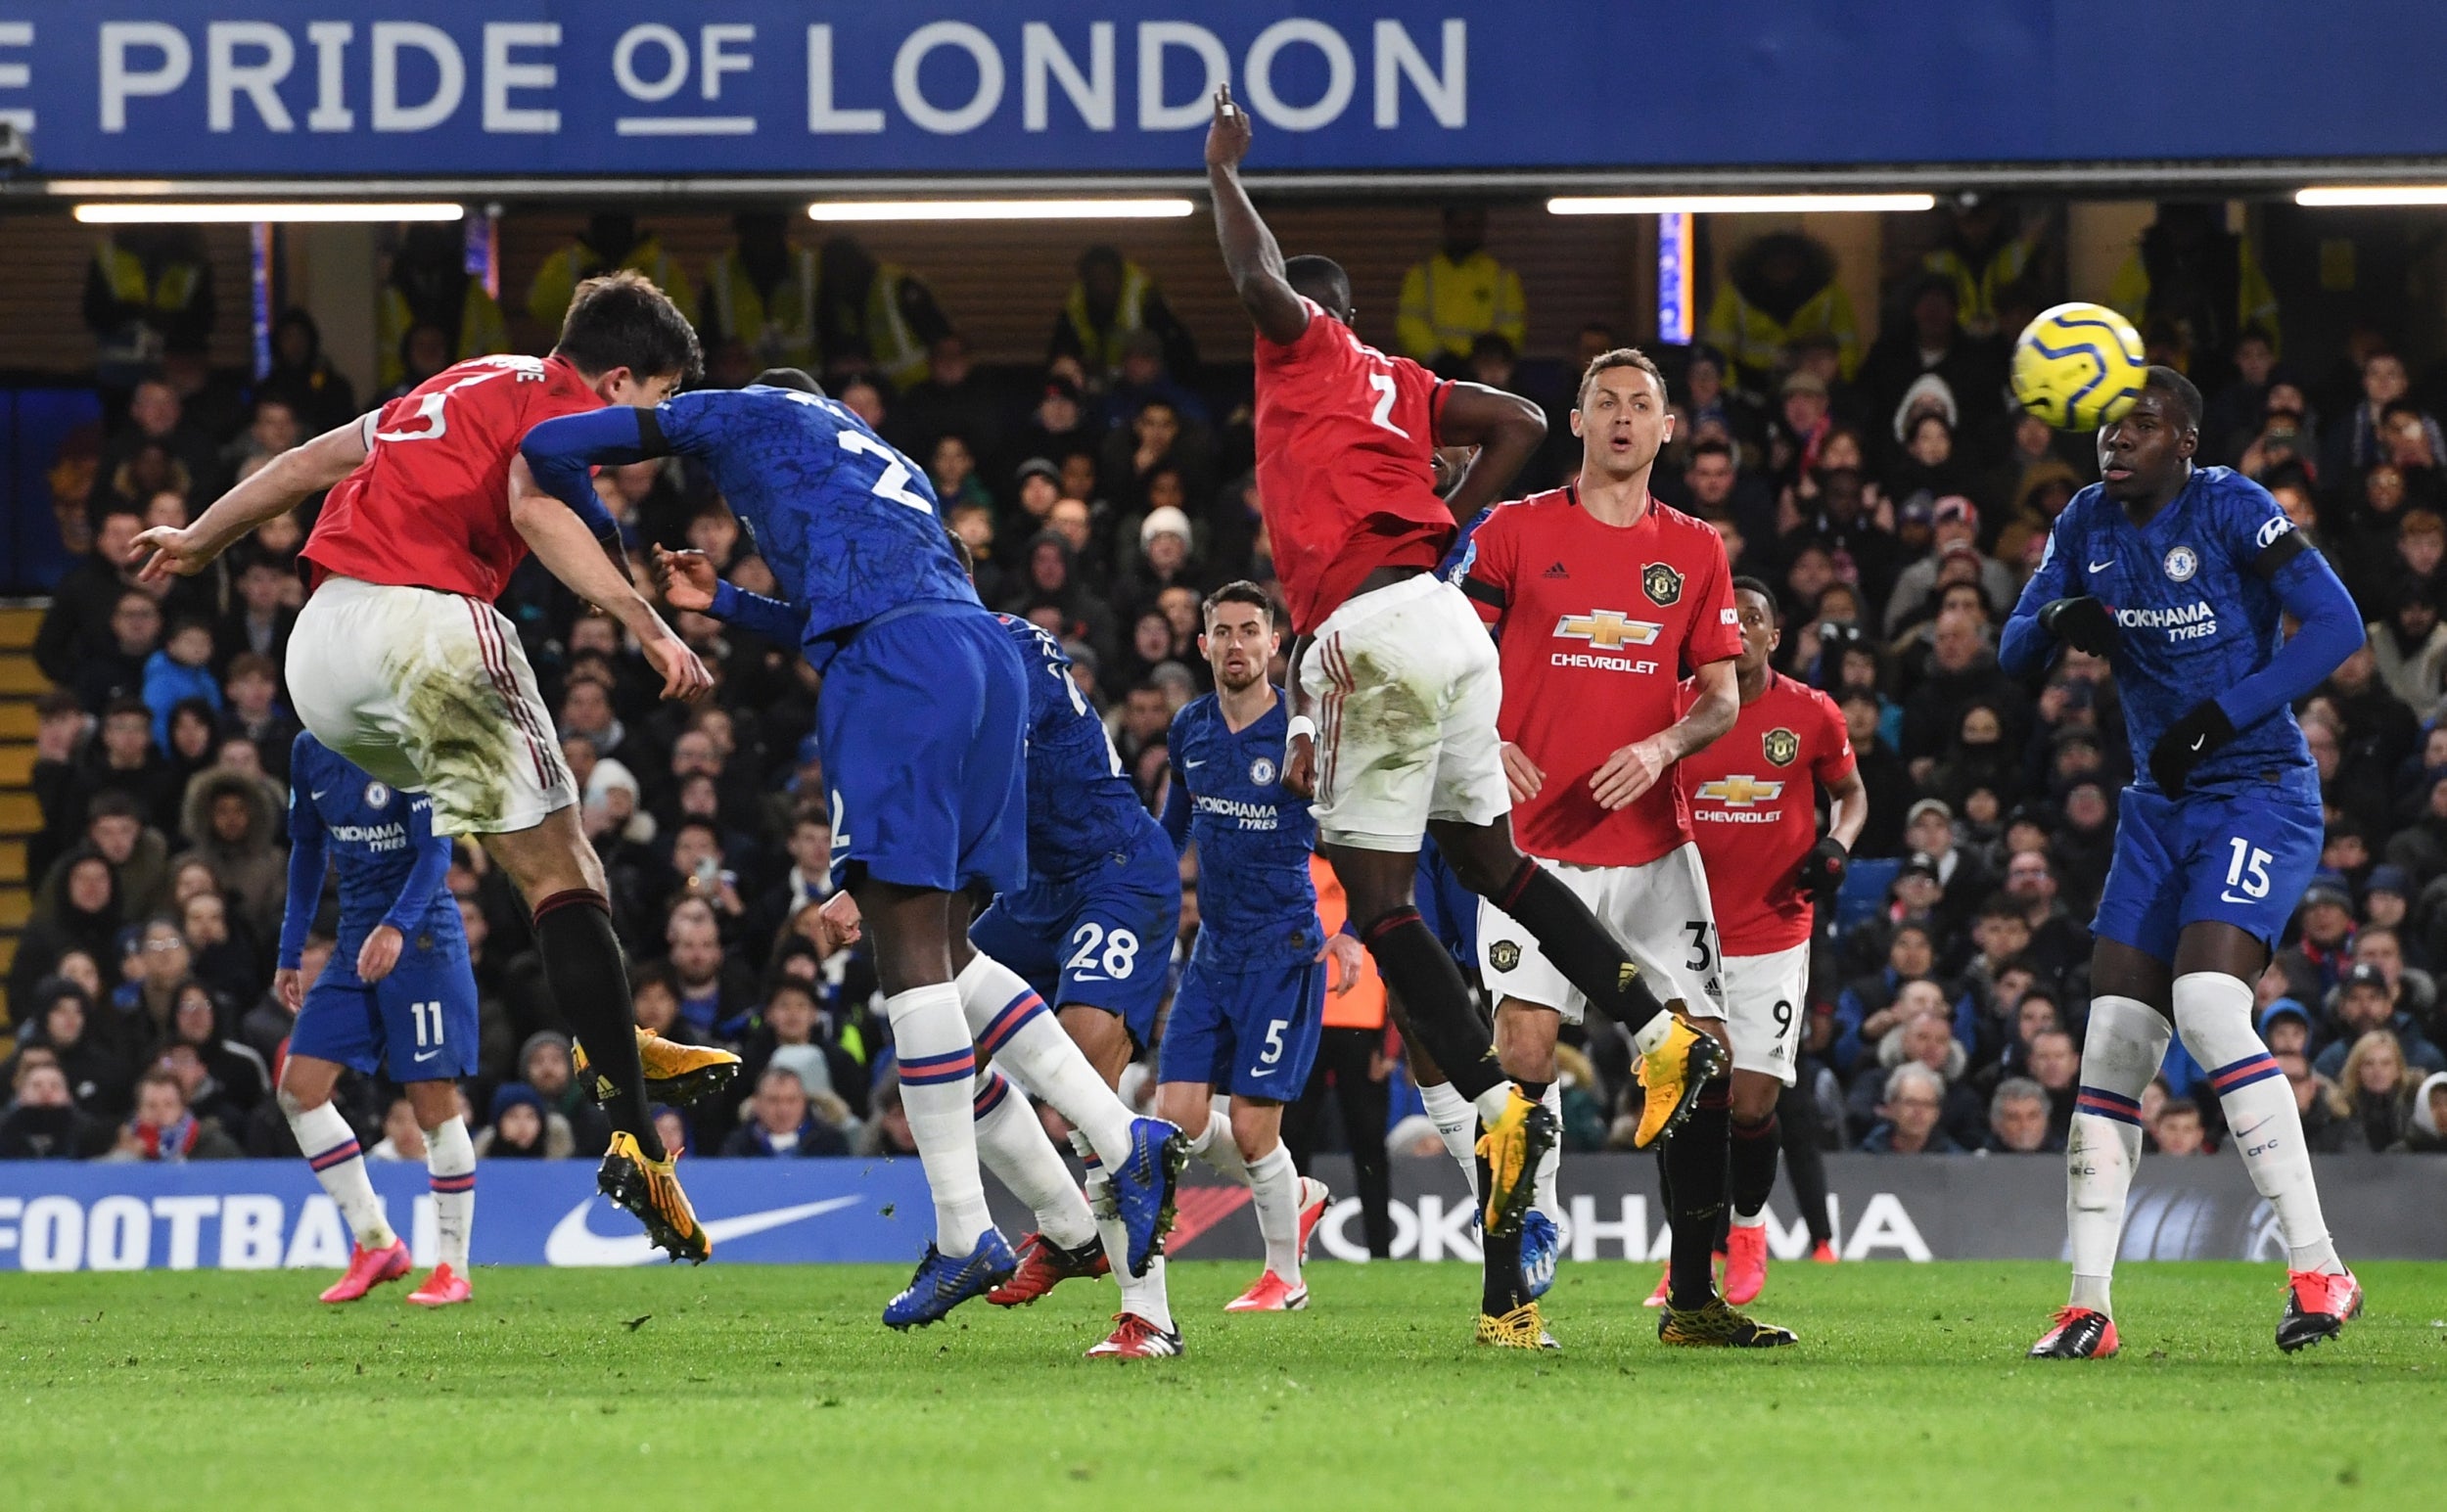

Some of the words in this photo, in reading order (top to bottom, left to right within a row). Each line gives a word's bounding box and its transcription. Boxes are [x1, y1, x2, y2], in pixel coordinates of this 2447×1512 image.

[100, 21, 563, 133] PRIDE
[612, 23, 757, 100] OF
[807, 18, 1467, 133] LONDON
[2115, 601, 2214, 627] YOKOHAMA
[2168, 620, 2218, 642] TYRES
[1551, 653, 1658, 674] CHEVROLET
[1197, 795, 1278, 819] YOKOHAMA
[1694, 810, 1781, 823] CHEVROLET
[1238, 818, 1278, 831] TYRES
[369, 836, 407, 853] TYRES
[2225, 836, 2274, 898] 15
[1066, 922, 1139, 980] 28
[411, 1001, 444, 1047] 11
[1773, 999, 1792, 1039] 9
[1260, 1019, 1289, 1064] 5
[2246, 1139, 2280, 1158] CFC
